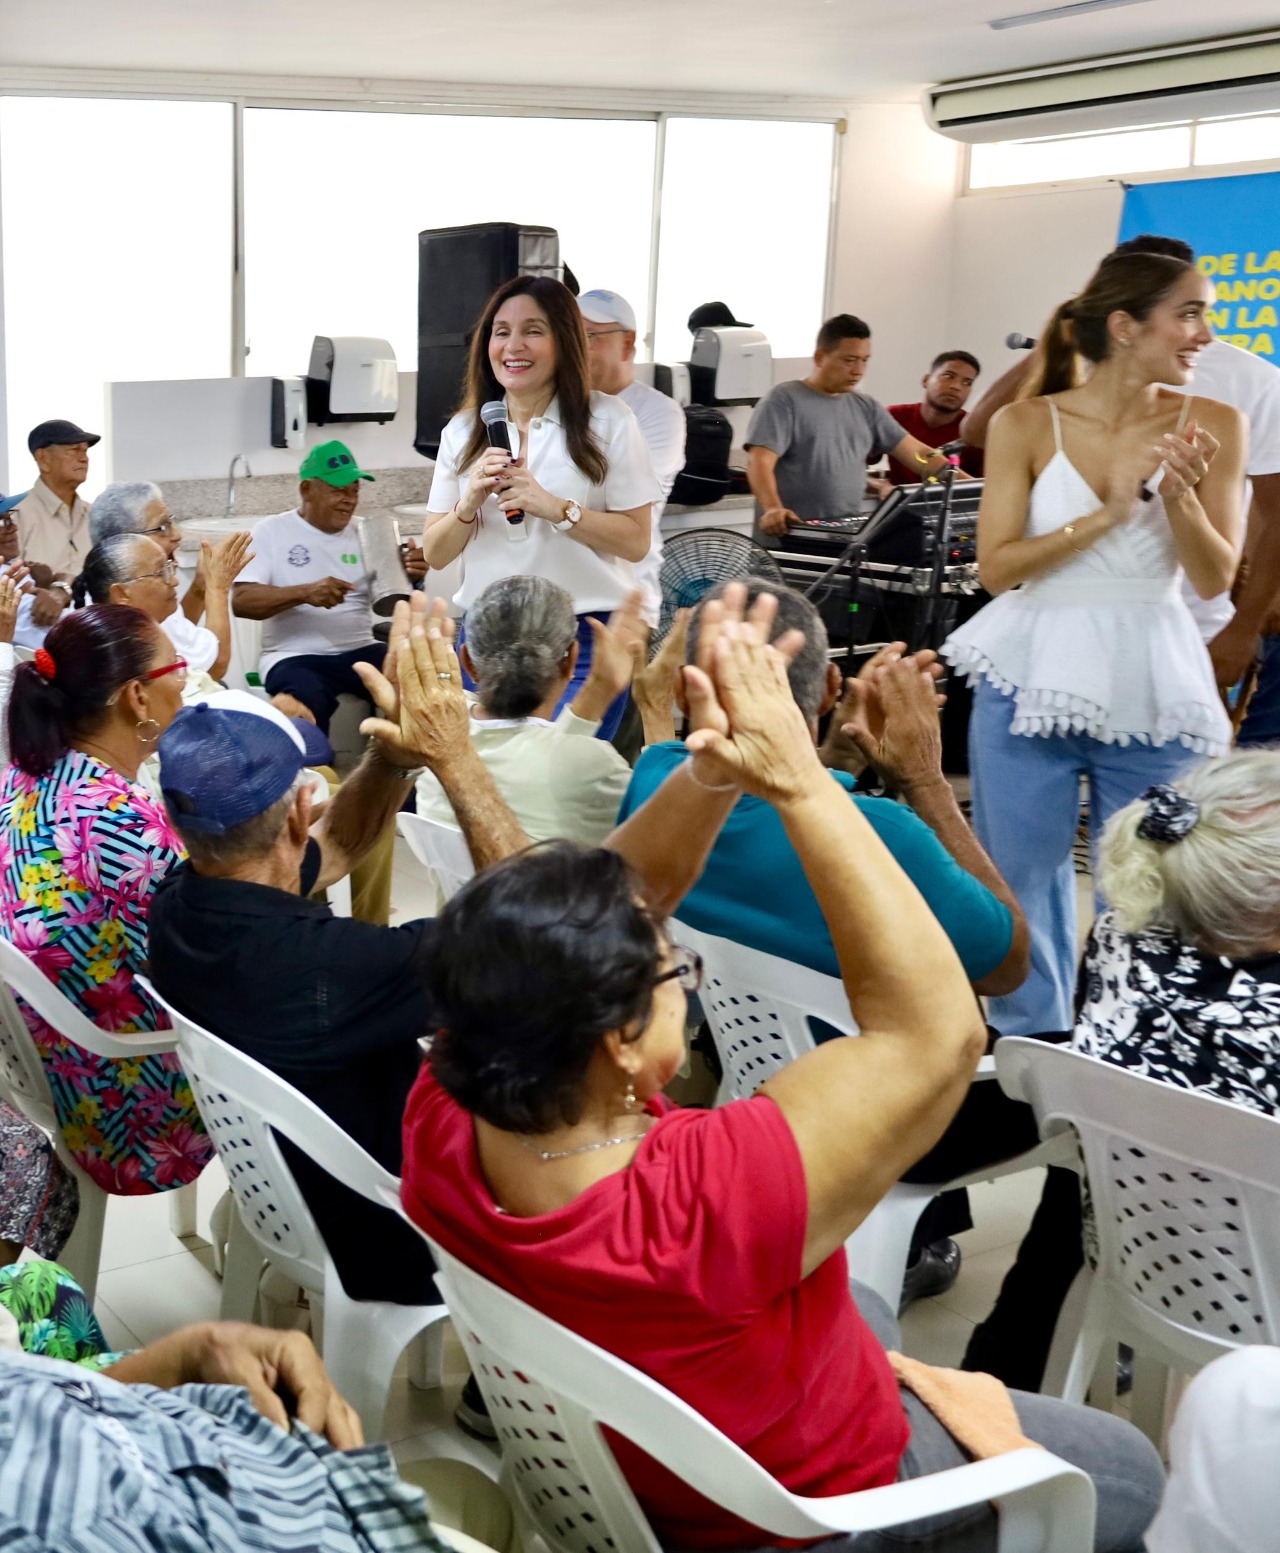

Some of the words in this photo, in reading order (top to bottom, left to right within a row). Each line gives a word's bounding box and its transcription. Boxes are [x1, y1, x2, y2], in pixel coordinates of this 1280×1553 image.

[1196, 253, 1239, 277] DE
[1245, 250, 1280, 274] LA
[1215, 278, 1280, 302] ANO
[1206, 307, 1230, 330] N
[1236, 305, 1279, 329] LA
[1215, 333, 1275, 355] RA
